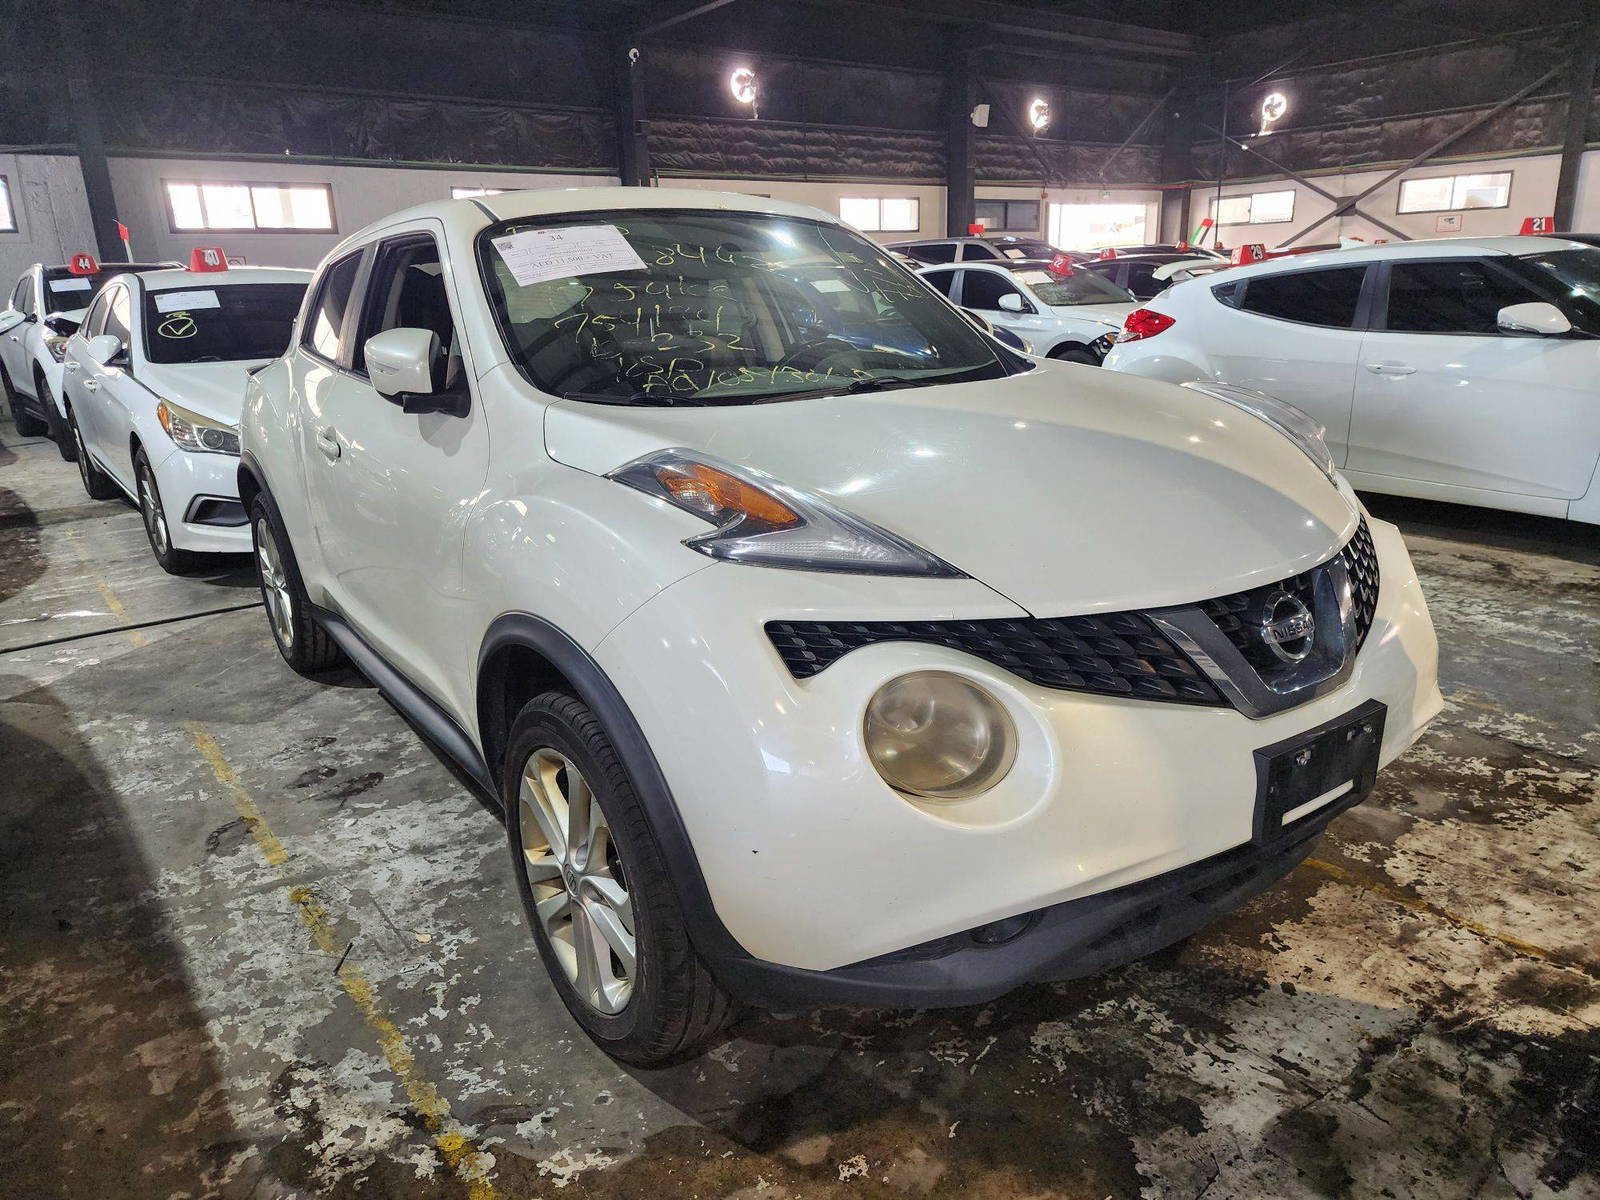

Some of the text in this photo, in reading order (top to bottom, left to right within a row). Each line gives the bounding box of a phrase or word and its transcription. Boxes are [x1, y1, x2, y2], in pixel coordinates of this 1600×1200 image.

[1532, 217, 1546, 231] 21
[550, 234, 564, 242] 34
[202, 249, 219, 266] 40
[1251, 245, 1263, 259] 29
[78, 257, 91, 270] 44
[1273, 616, 1314, 641] NISSAN
